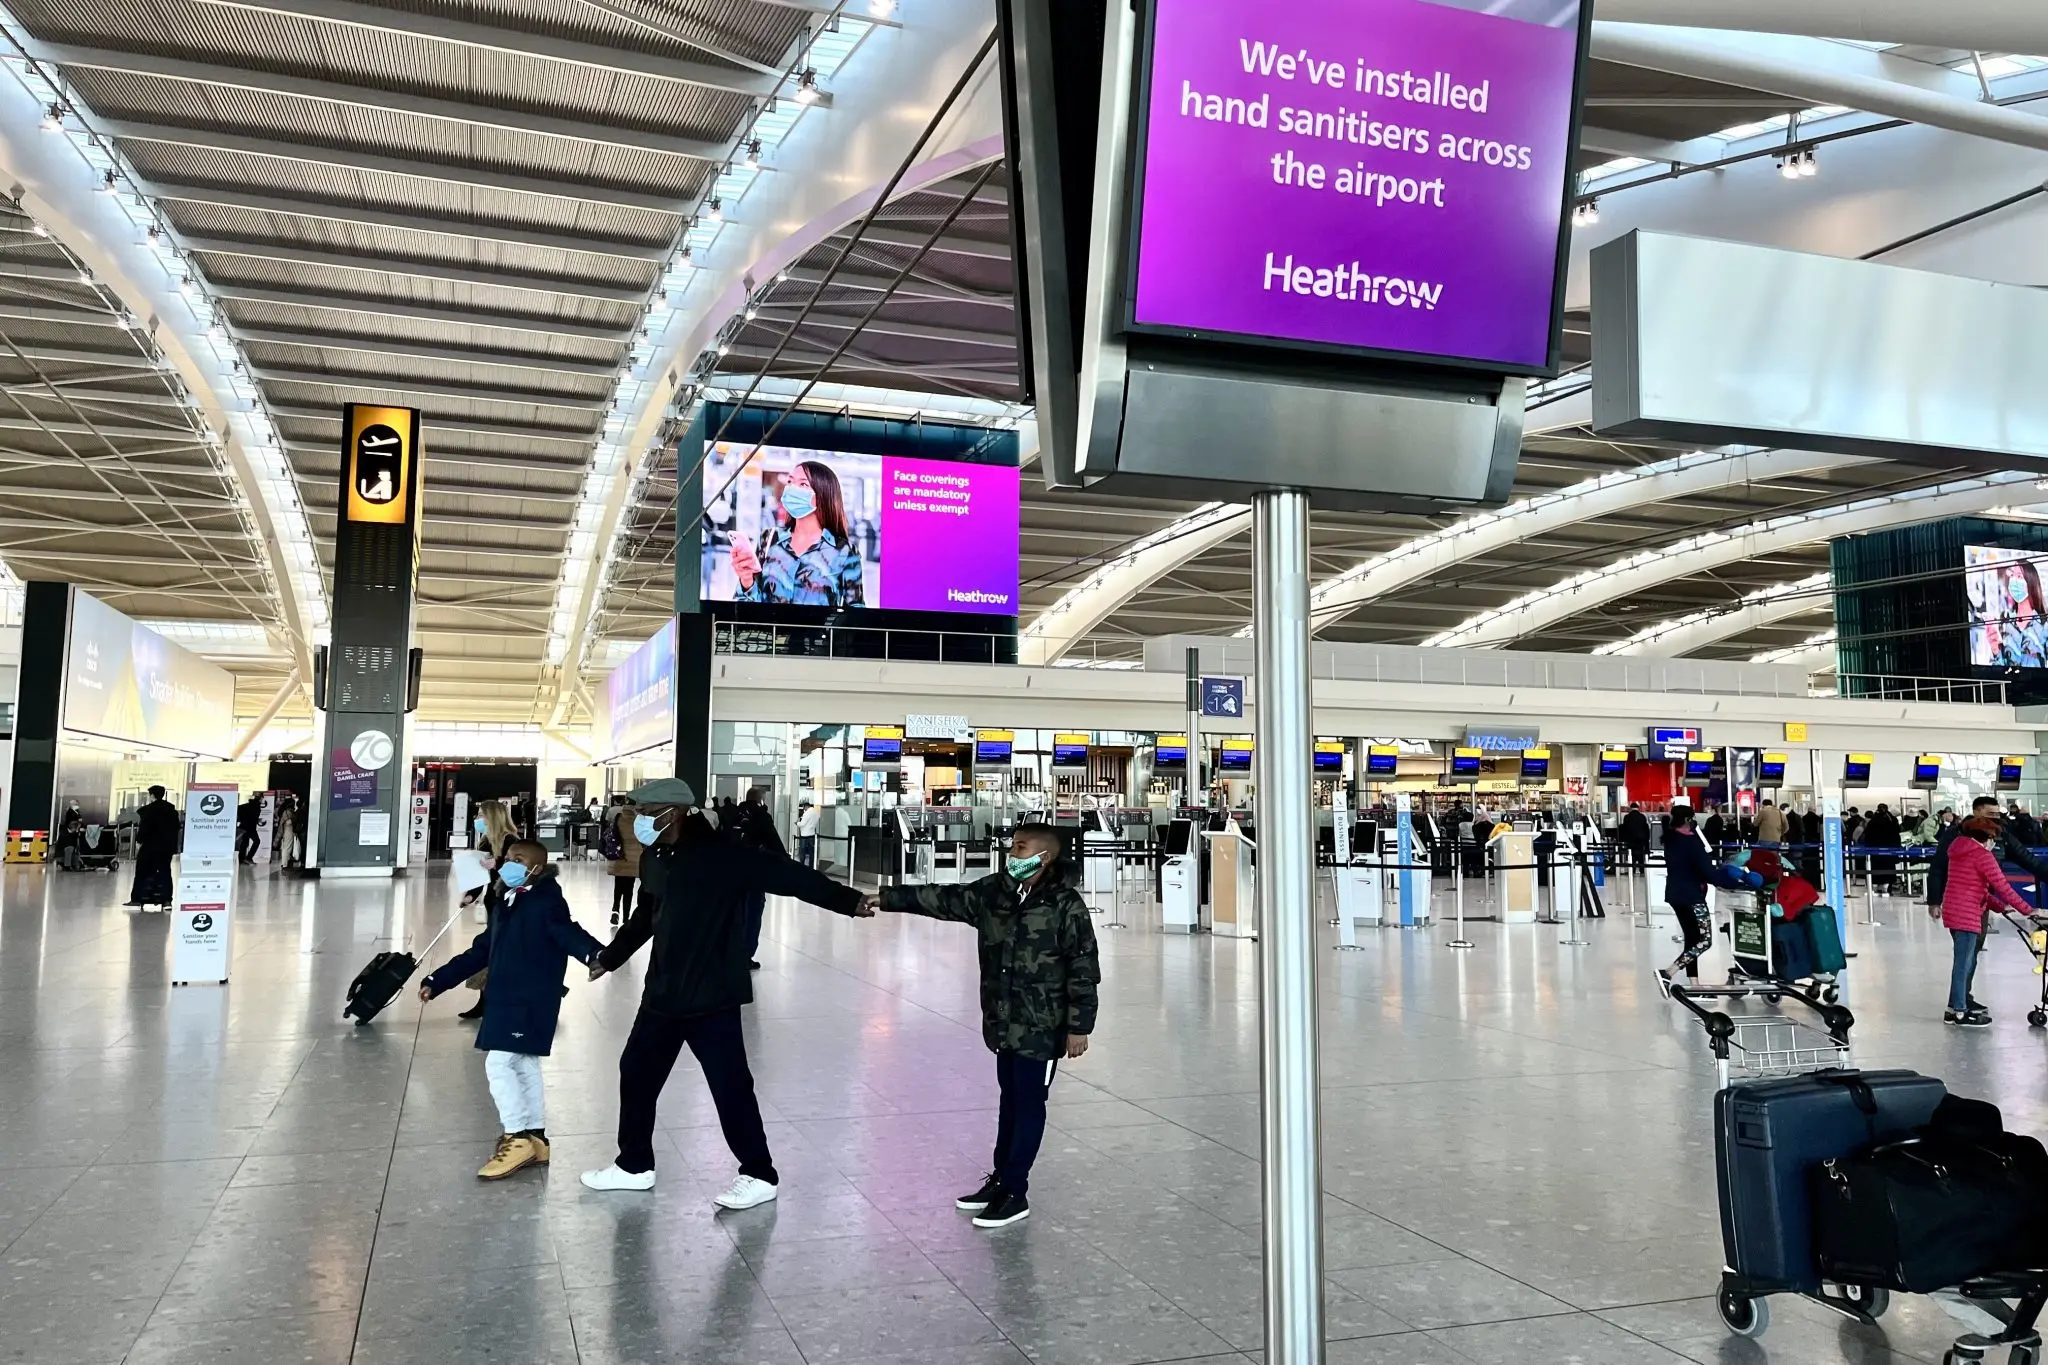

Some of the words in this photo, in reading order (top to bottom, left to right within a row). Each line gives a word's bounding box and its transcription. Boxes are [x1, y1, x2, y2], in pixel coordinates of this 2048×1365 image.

[1239, 38, 1346, 89] We've
[1355, 58, 1490, 114] installed
[1180, 80, 1269, 129] hand
[1278, 106, 1430, 154] sanitisers
[1438, 131, 1532, 170] across
[1271, 151, 1326, 190] the
[1335, 162, 1446, 208] airport
[1263, 252, 1444, 311] Heathrow
[893, 470, 918, 483] Face
[919, 473, 970, 487] coverings
[893, 487, 911, 496] are
[913, 486, 971, 502] mandatory
[893, 500, 926, 512] unless
[929, 503, 970, 516] exempt
[947, 588, 1009, 605] Heathrow
[907, 715, 968, 726] KANISHKA
[907, 727, 957, 737] KITCHEN
[1468, 735, 1536, 751] WHSmith
